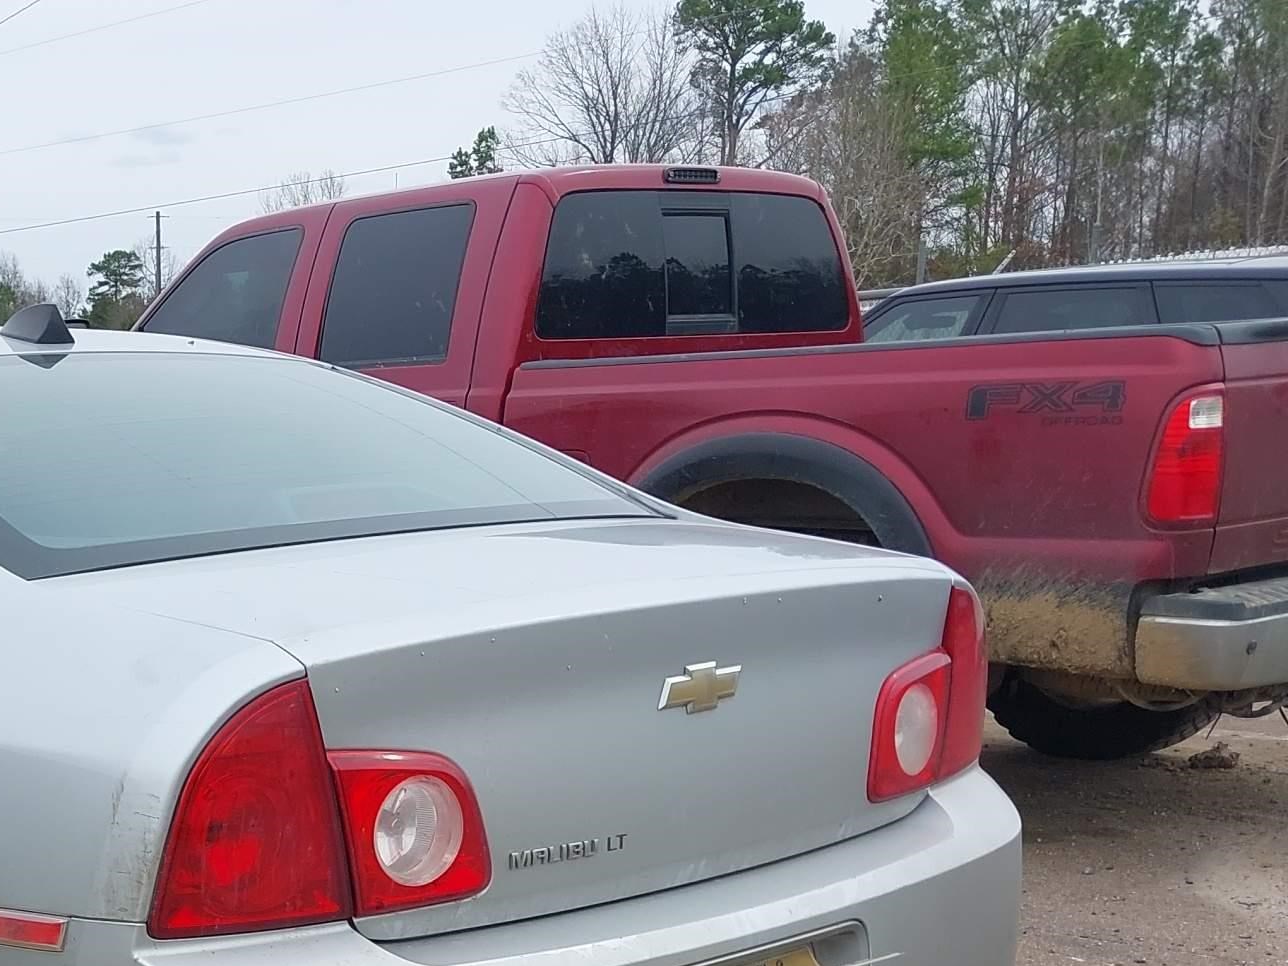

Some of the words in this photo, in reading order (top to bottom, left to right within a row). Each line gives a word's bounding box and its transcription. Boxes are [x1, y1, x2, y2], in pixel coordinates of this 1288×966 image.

[965, 380, 1127, 421] FX4
[509, 839, 599, 870] MALIBU
[607, 833, 627, 851] LT
